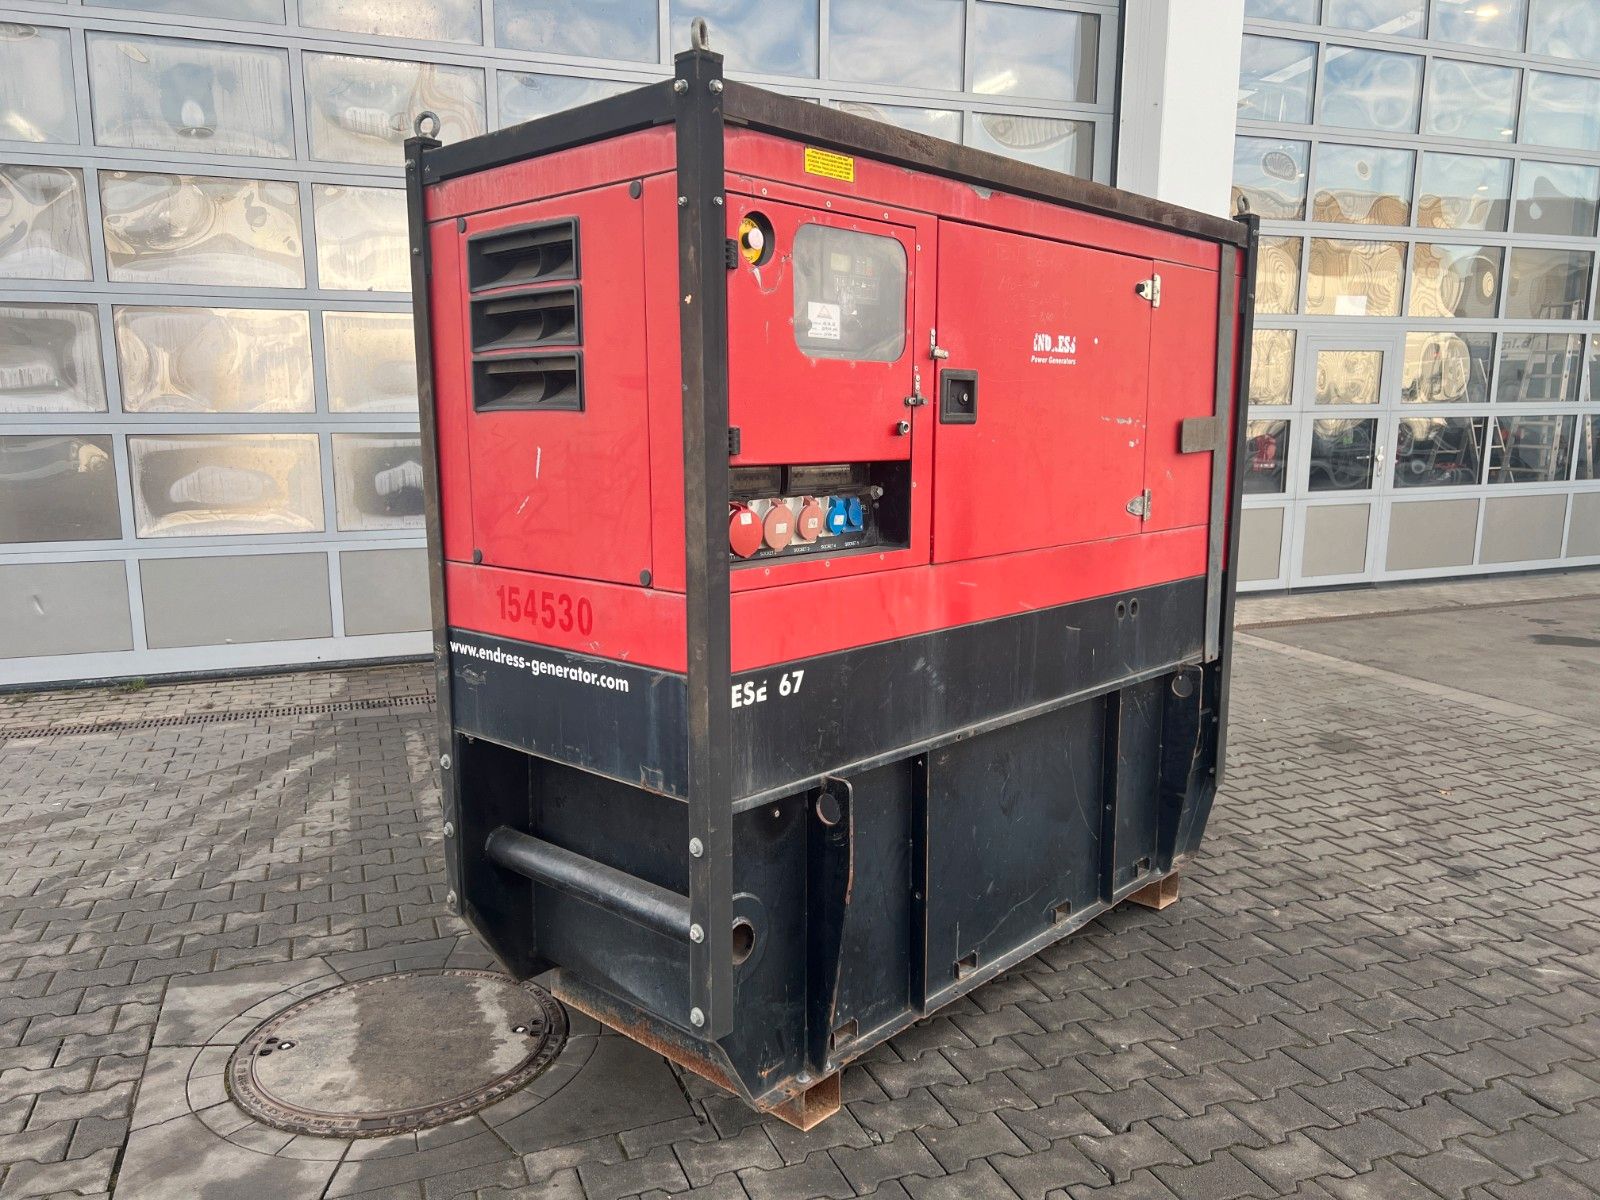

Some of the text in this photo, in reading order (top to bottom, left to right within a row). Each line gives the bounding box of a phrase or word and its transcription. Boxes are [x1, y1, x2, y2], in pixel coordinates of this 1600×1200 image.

[1031, 355, 1076, 365] Power Generators
[496, 584, 593, 636] 154530
[449, 639, 629, 692] www.endress-generator.com
[779, 670, 804, 697] 67
